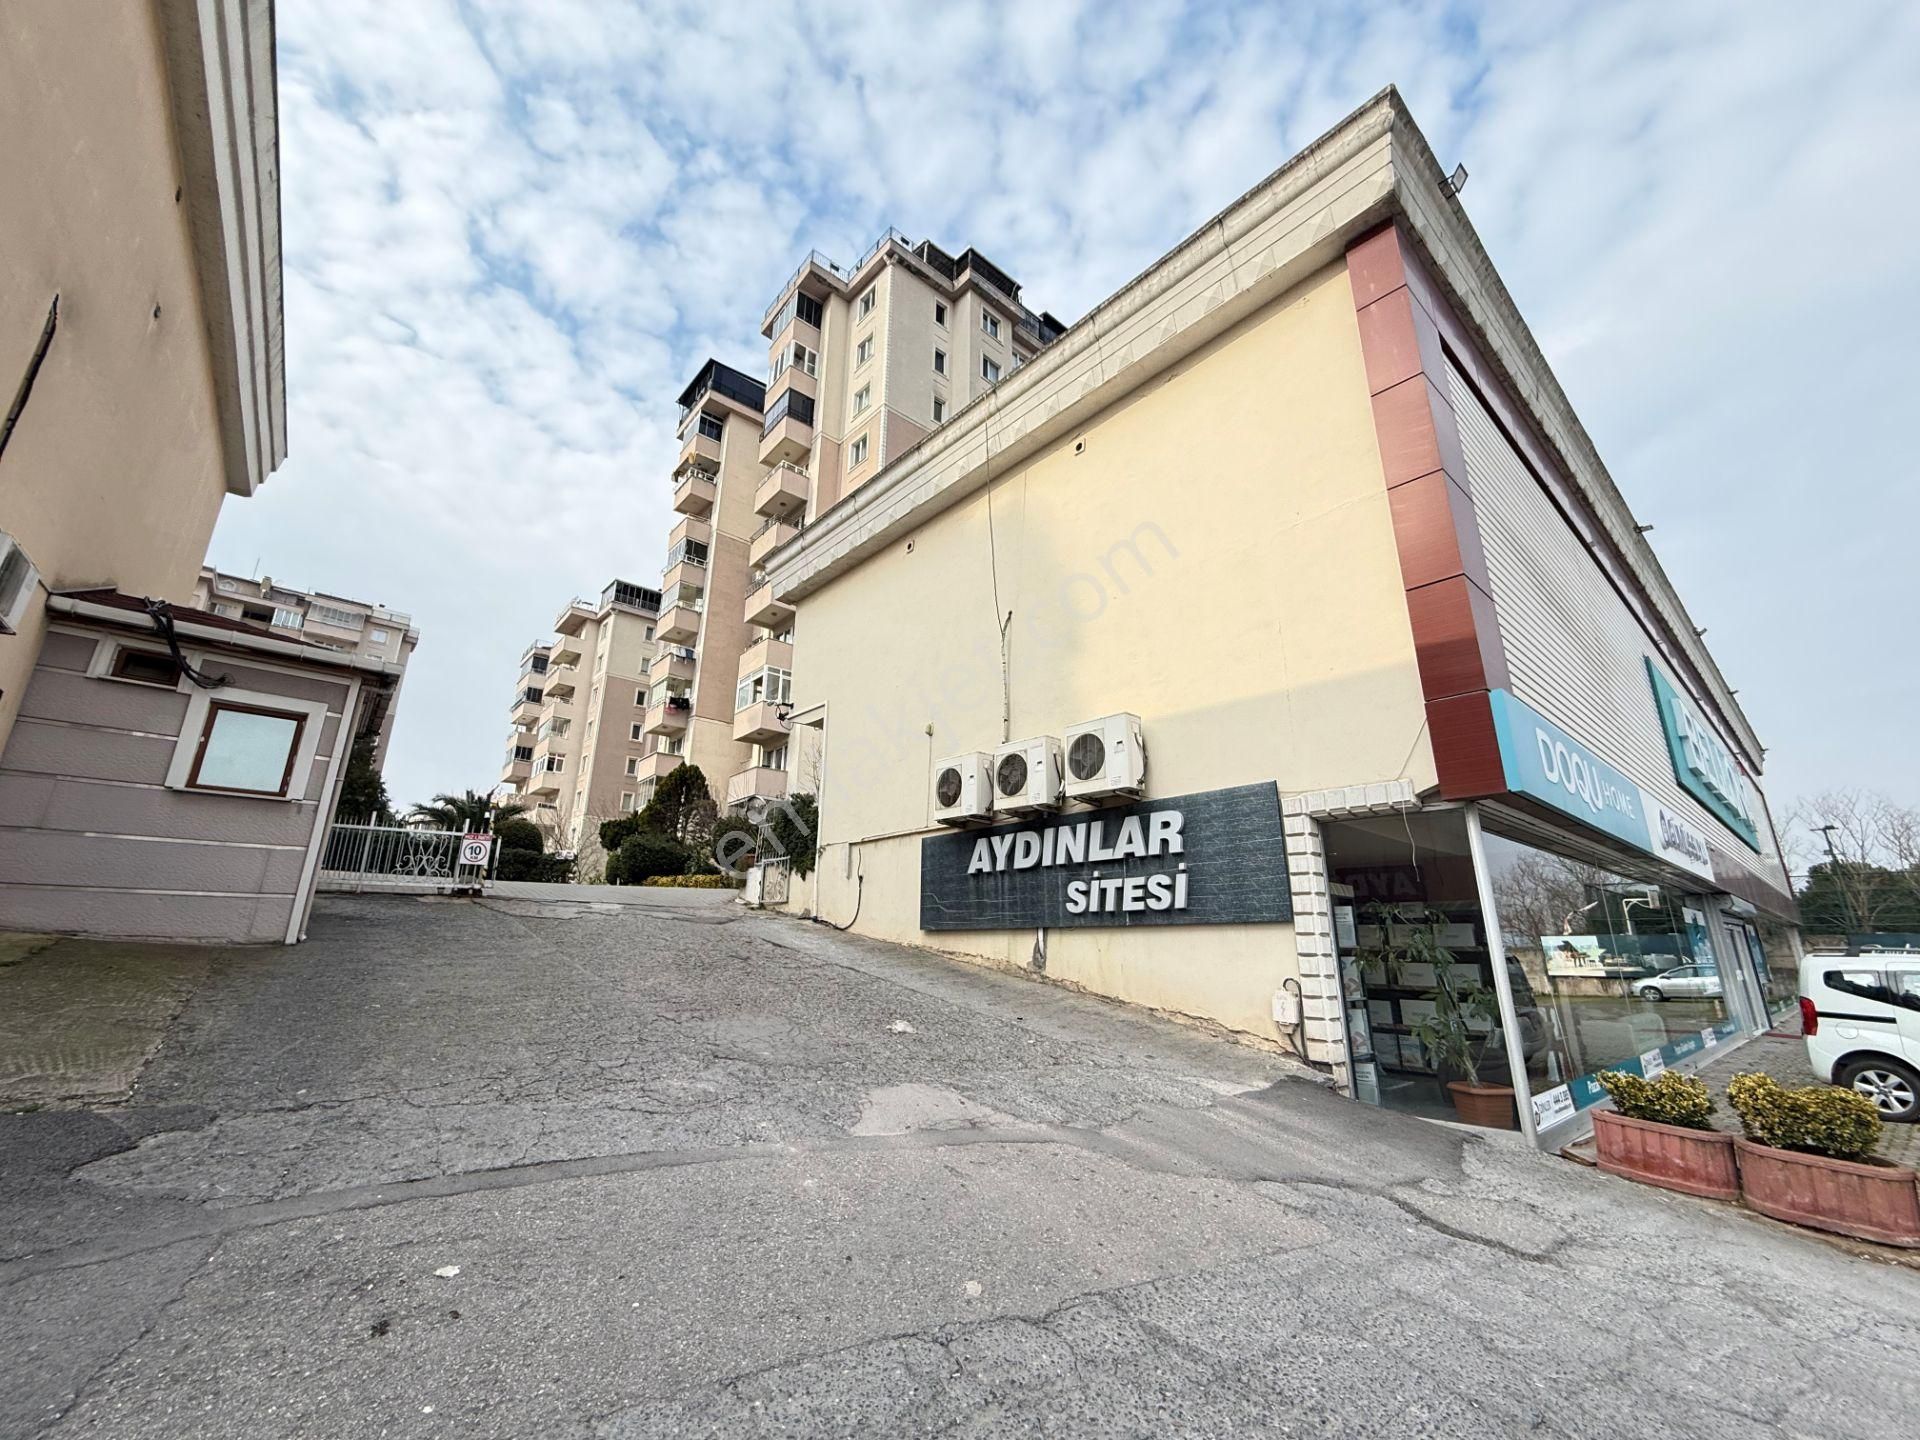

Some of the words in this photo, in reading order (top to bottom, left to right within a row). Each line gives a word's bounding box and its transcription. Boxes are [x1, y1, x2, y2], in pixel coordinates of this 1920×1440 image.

[1535, 727, 1603, 814] DOQU
[1601, 780, 1636, 820] HOME
[468, 845, 482, 856] 10
[967, 810, 1184, 875] AYDINLAR
[1065, 863, 1189, 914] SİTESİ
